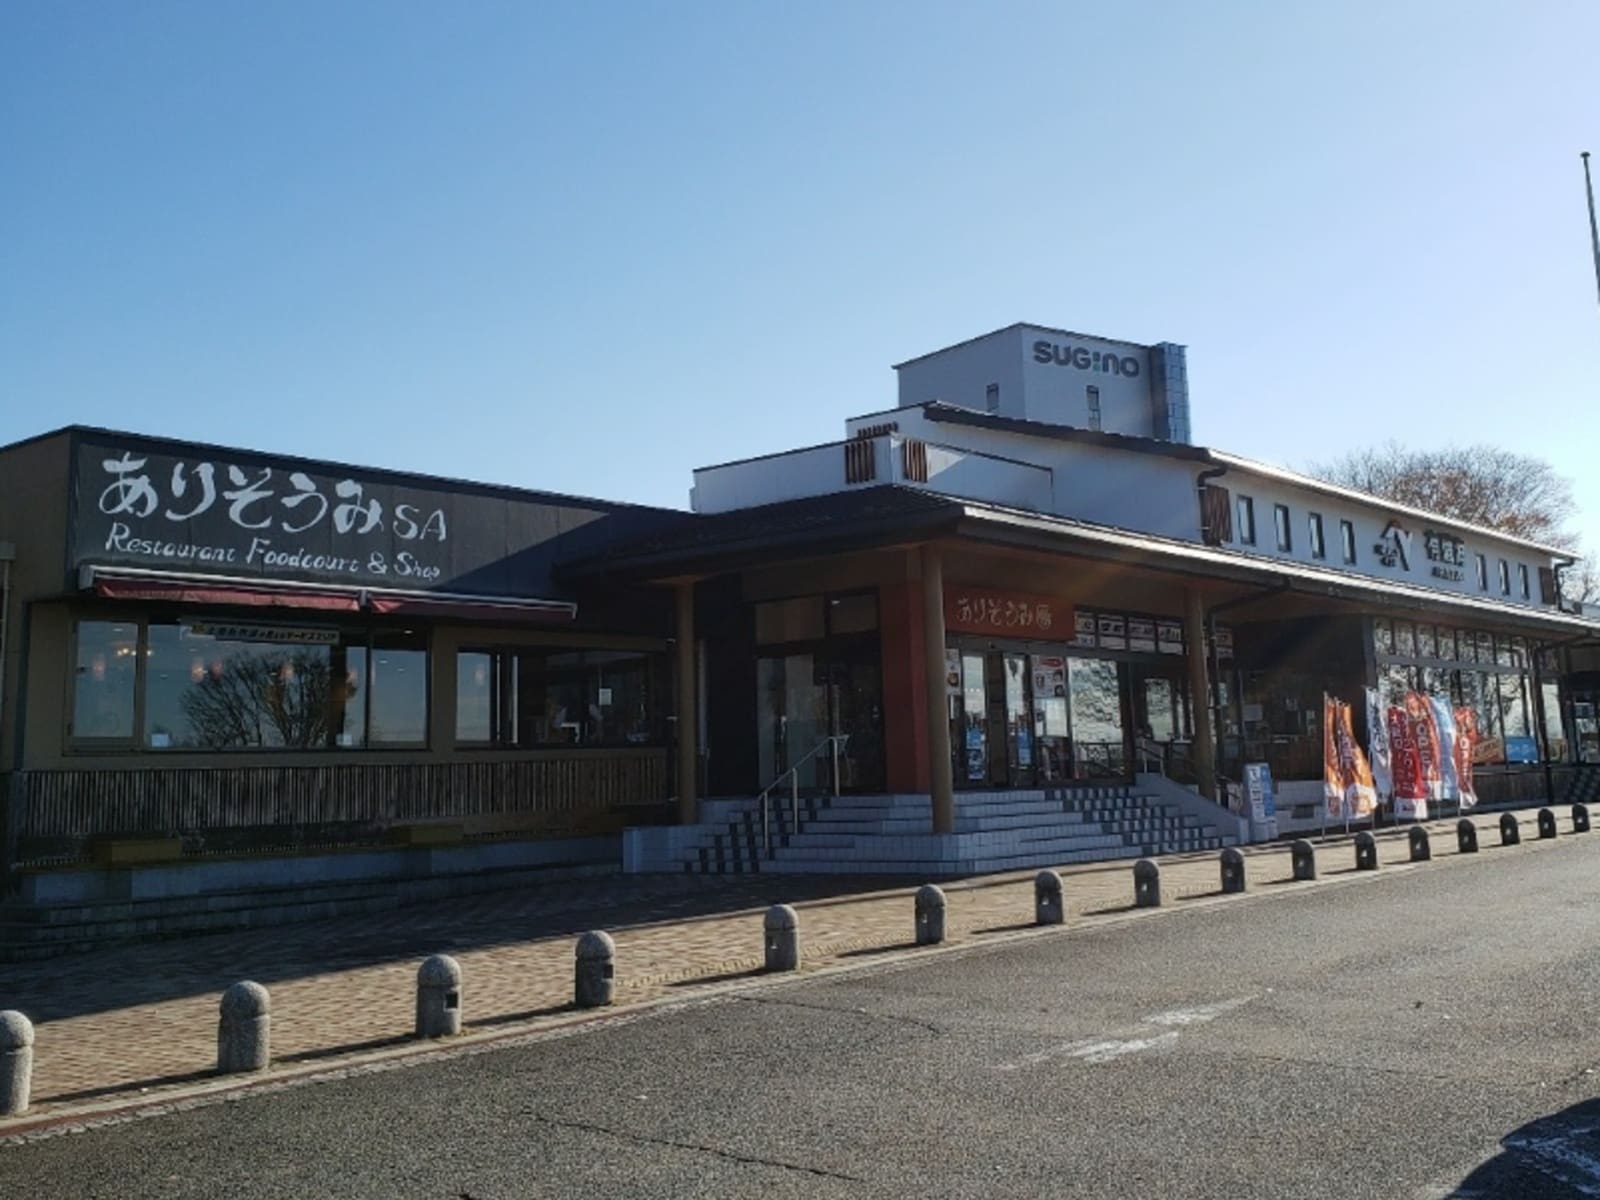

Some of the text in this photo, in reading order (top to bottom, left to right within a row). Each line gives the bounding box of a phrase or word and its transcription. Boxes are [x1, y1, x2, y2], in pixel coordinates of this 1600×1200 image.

[105, 522, 441, 580] Restaurant Foodcourt & Shop
